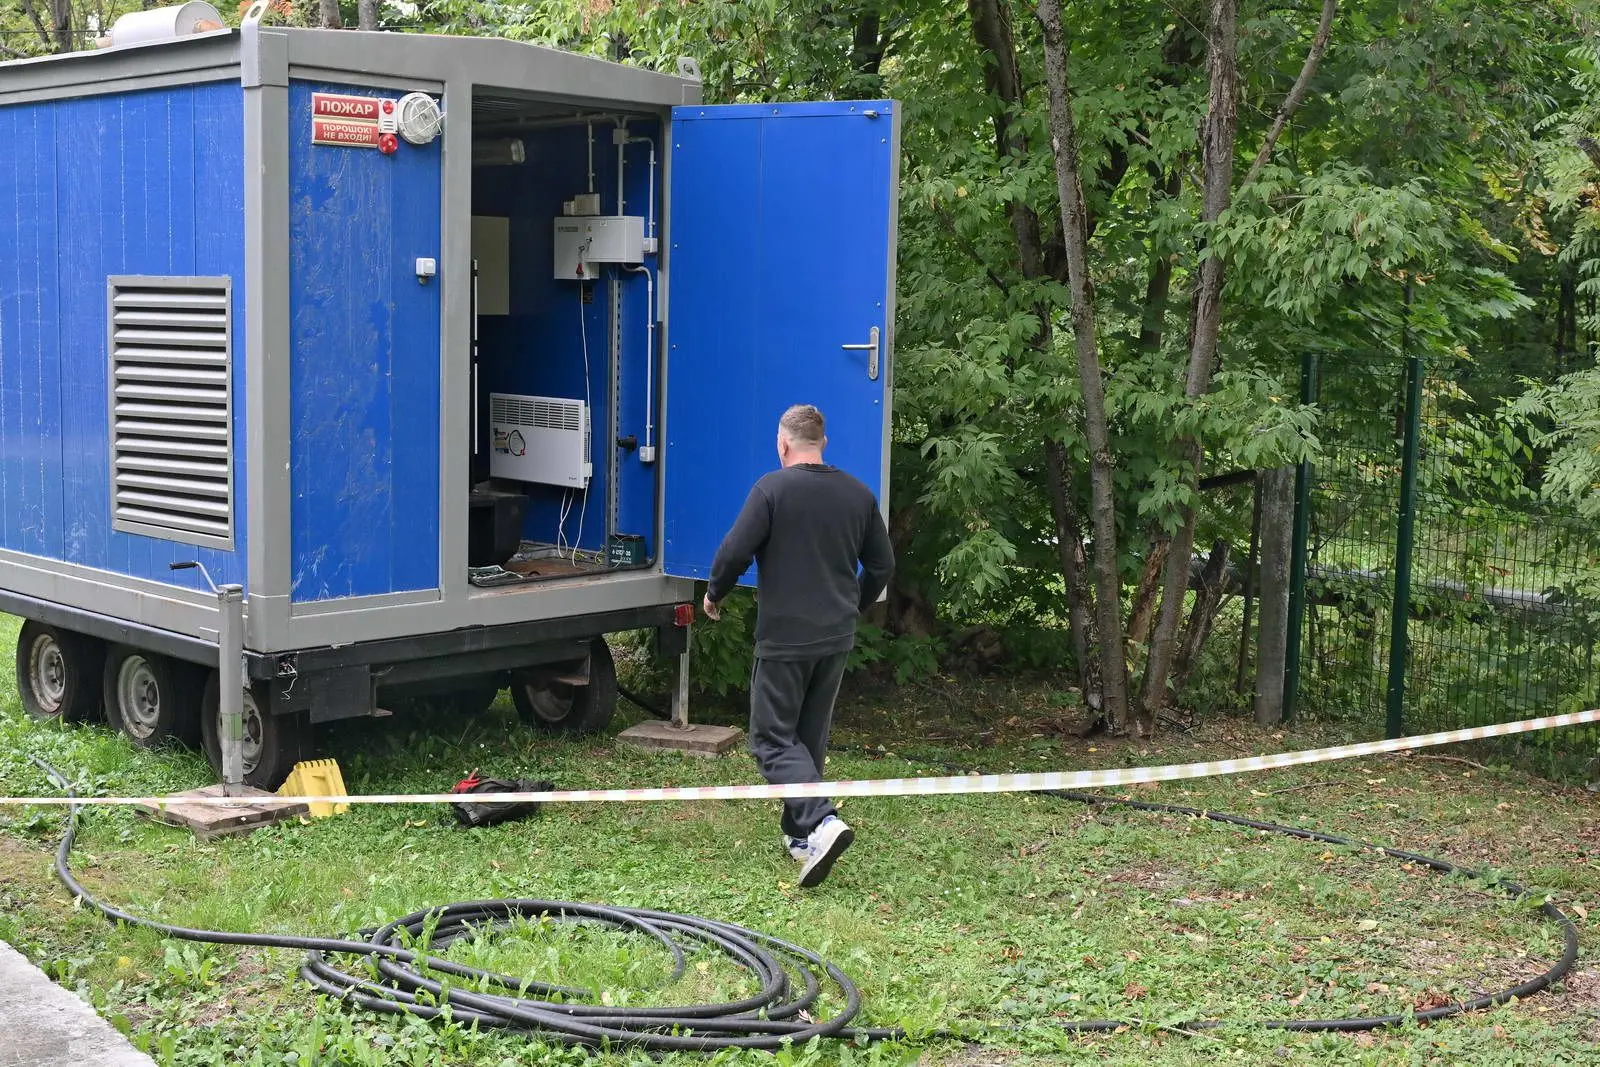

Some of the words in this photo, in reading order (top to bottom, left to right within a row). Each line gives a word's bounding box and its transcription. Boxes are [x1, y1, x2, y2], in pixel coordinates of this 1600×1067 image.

[320, 100, 374, 115] ПОЖАР
[322, 124, 372, 134] ПОРОШОК!
[338, 133, 372, 141] ВХОДИ!
